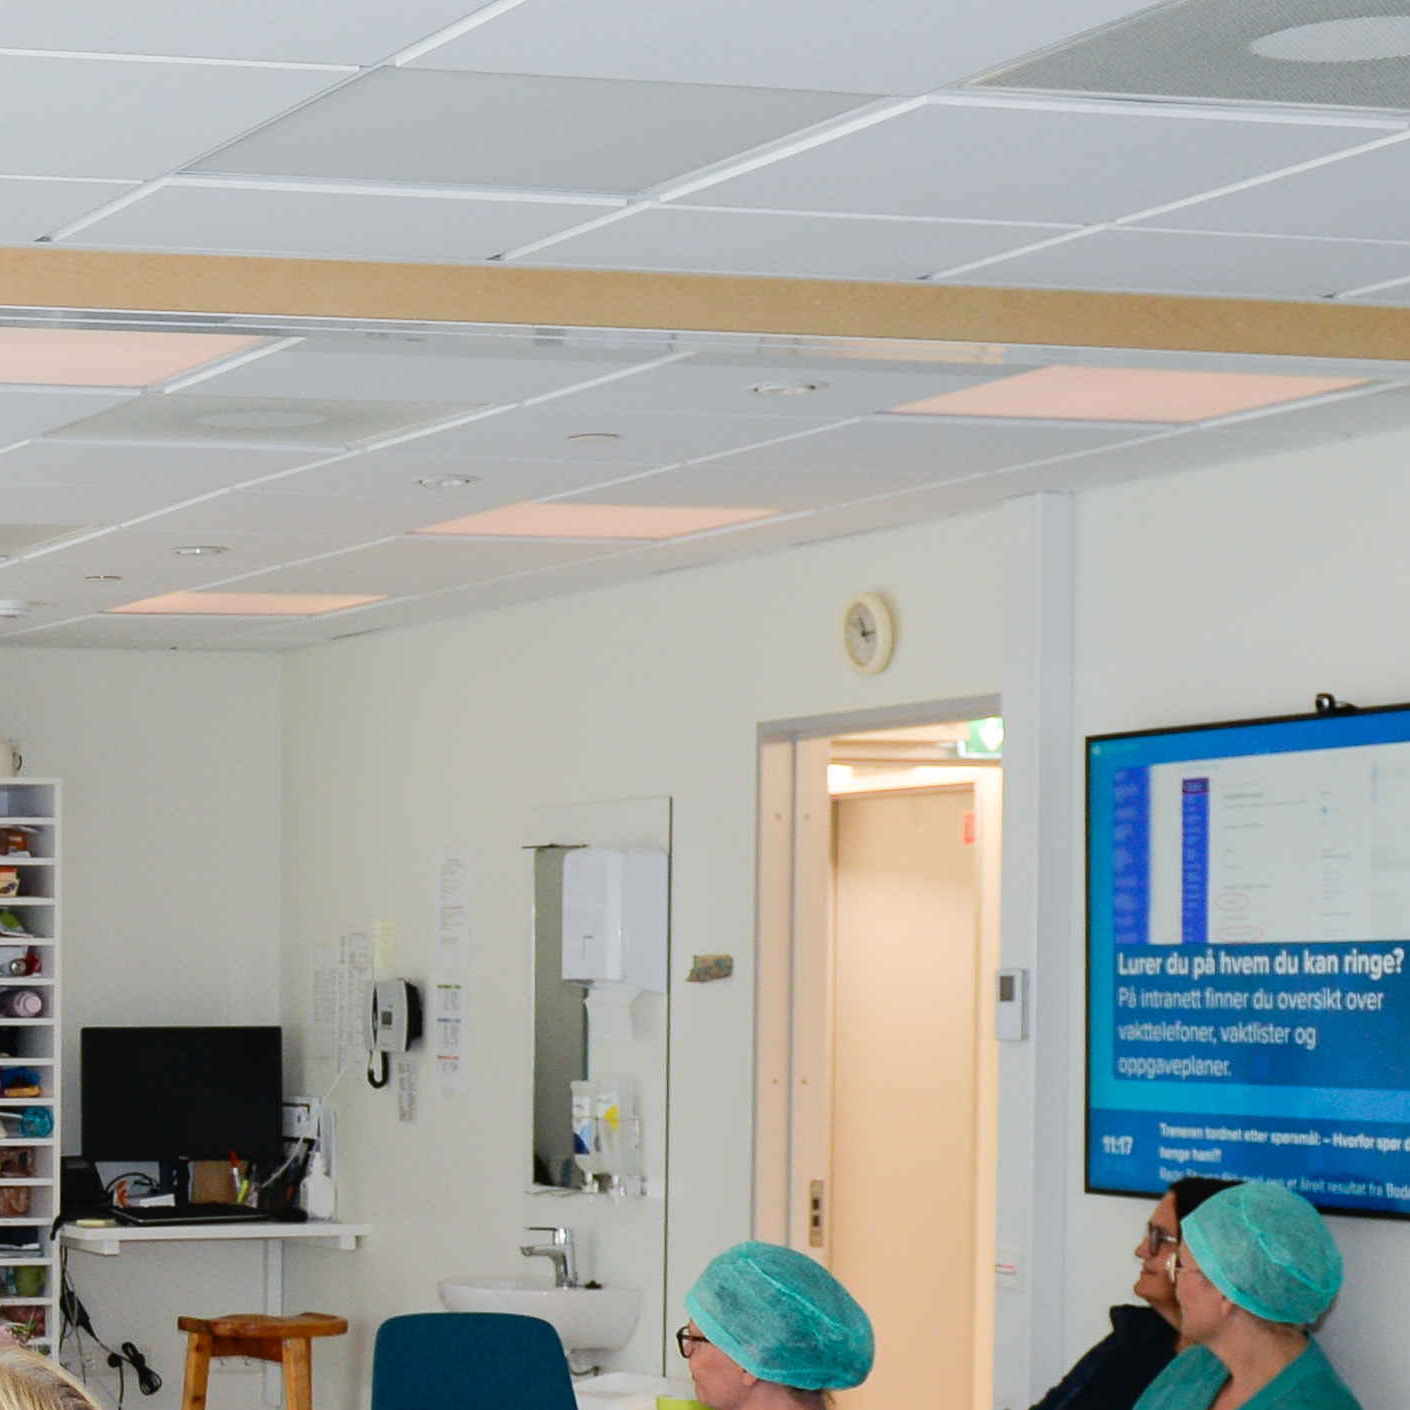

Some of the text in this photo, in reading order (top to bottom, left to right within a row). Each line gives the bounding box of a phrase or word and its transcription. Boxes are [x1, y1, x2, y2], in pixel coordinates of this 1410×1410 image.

[1117, 947, 1405, 980] Lurer du på hvem du kan ringe?
[1118, 985, 1384, 1010] På intranett finner du oversikt over
[1118, 1022, 1316, 1050] vakttelefoner, vaktlister og
[1118, 1056, 1232, 1080] oppgaveplaner.
[1102, 1135, 1134, 1154] 11:17
